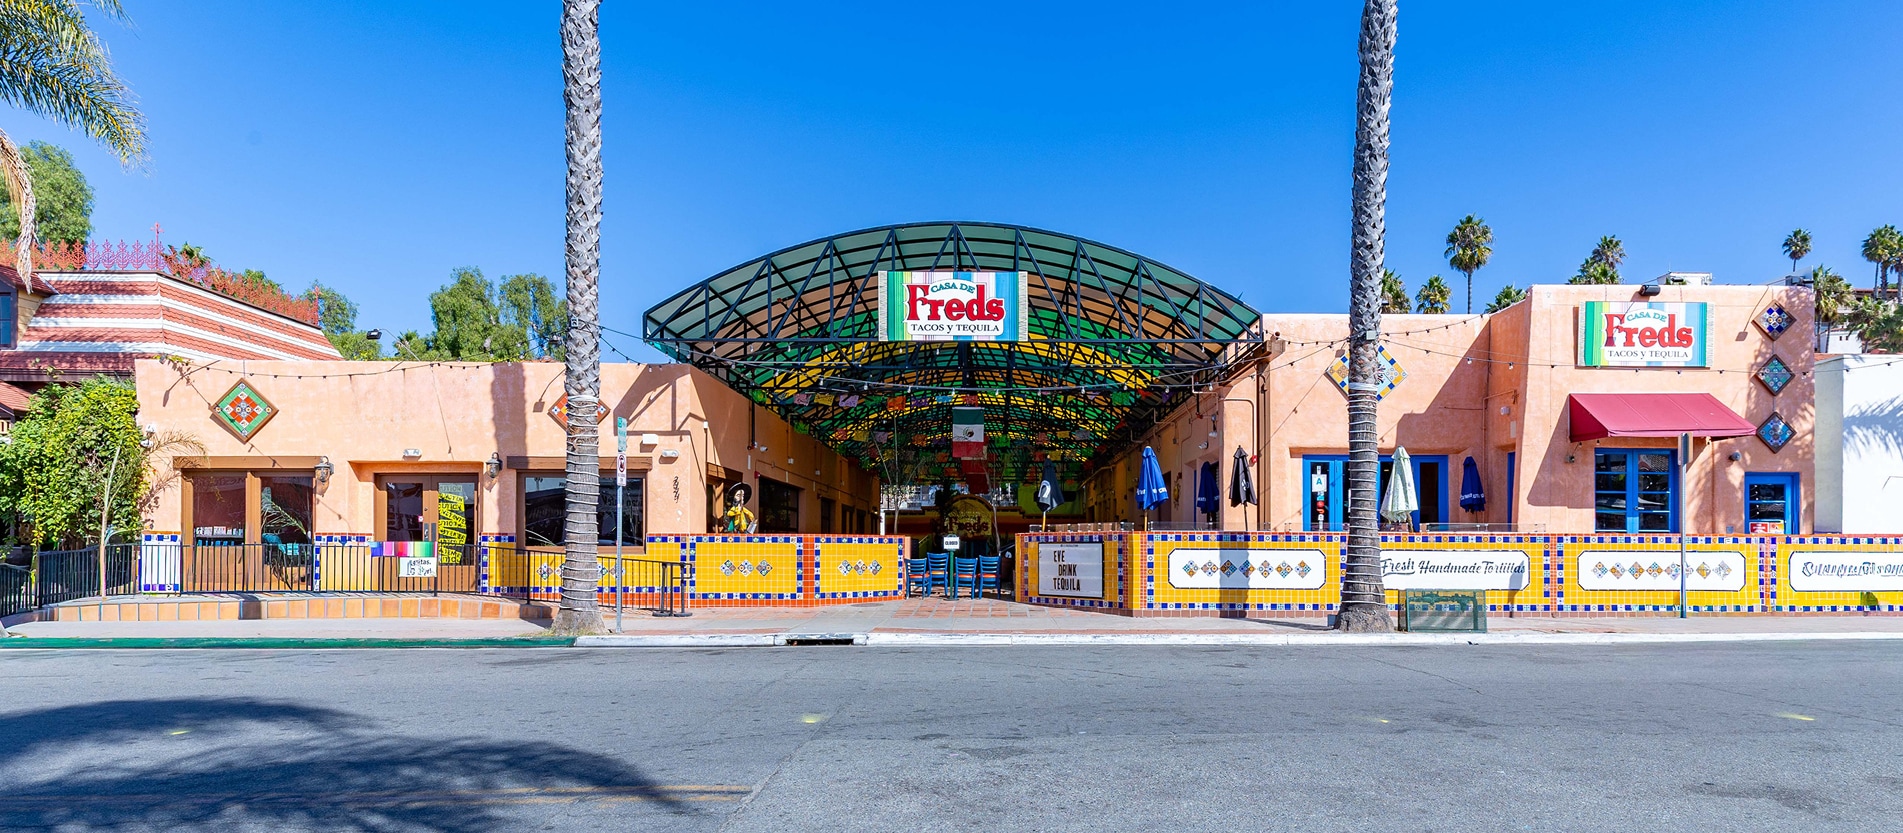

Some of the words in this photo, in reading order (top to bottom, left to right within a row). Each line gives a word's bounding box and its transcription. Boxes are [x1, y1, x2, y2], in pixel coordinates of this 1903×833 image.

[930, 282, 958, 293] CASA
[959, 283, 976, 294] DE
[906, 284, 1005, 322] Freds
[1626, 312, 1651, 322] CASA
[1652, 312, 1668, 323] DE
[911, 324, 945, 332] TACOS
[955, 324, 1000, 332] TEQUILA
[1604, 313, 1694, 348] Freds
[1608, 350, 1639, 358] TACOS
[1649, 350, 1689, 358] TEQUILA
[1316, 477, 1323, 485] A
[1058, 564, 1077, 577] DRINK
[1380, 558, 1415, 575] Fresh
[1418, 560, 1482, 574] Handmade
[1052, 577, 1081, 591] TEQUILA
